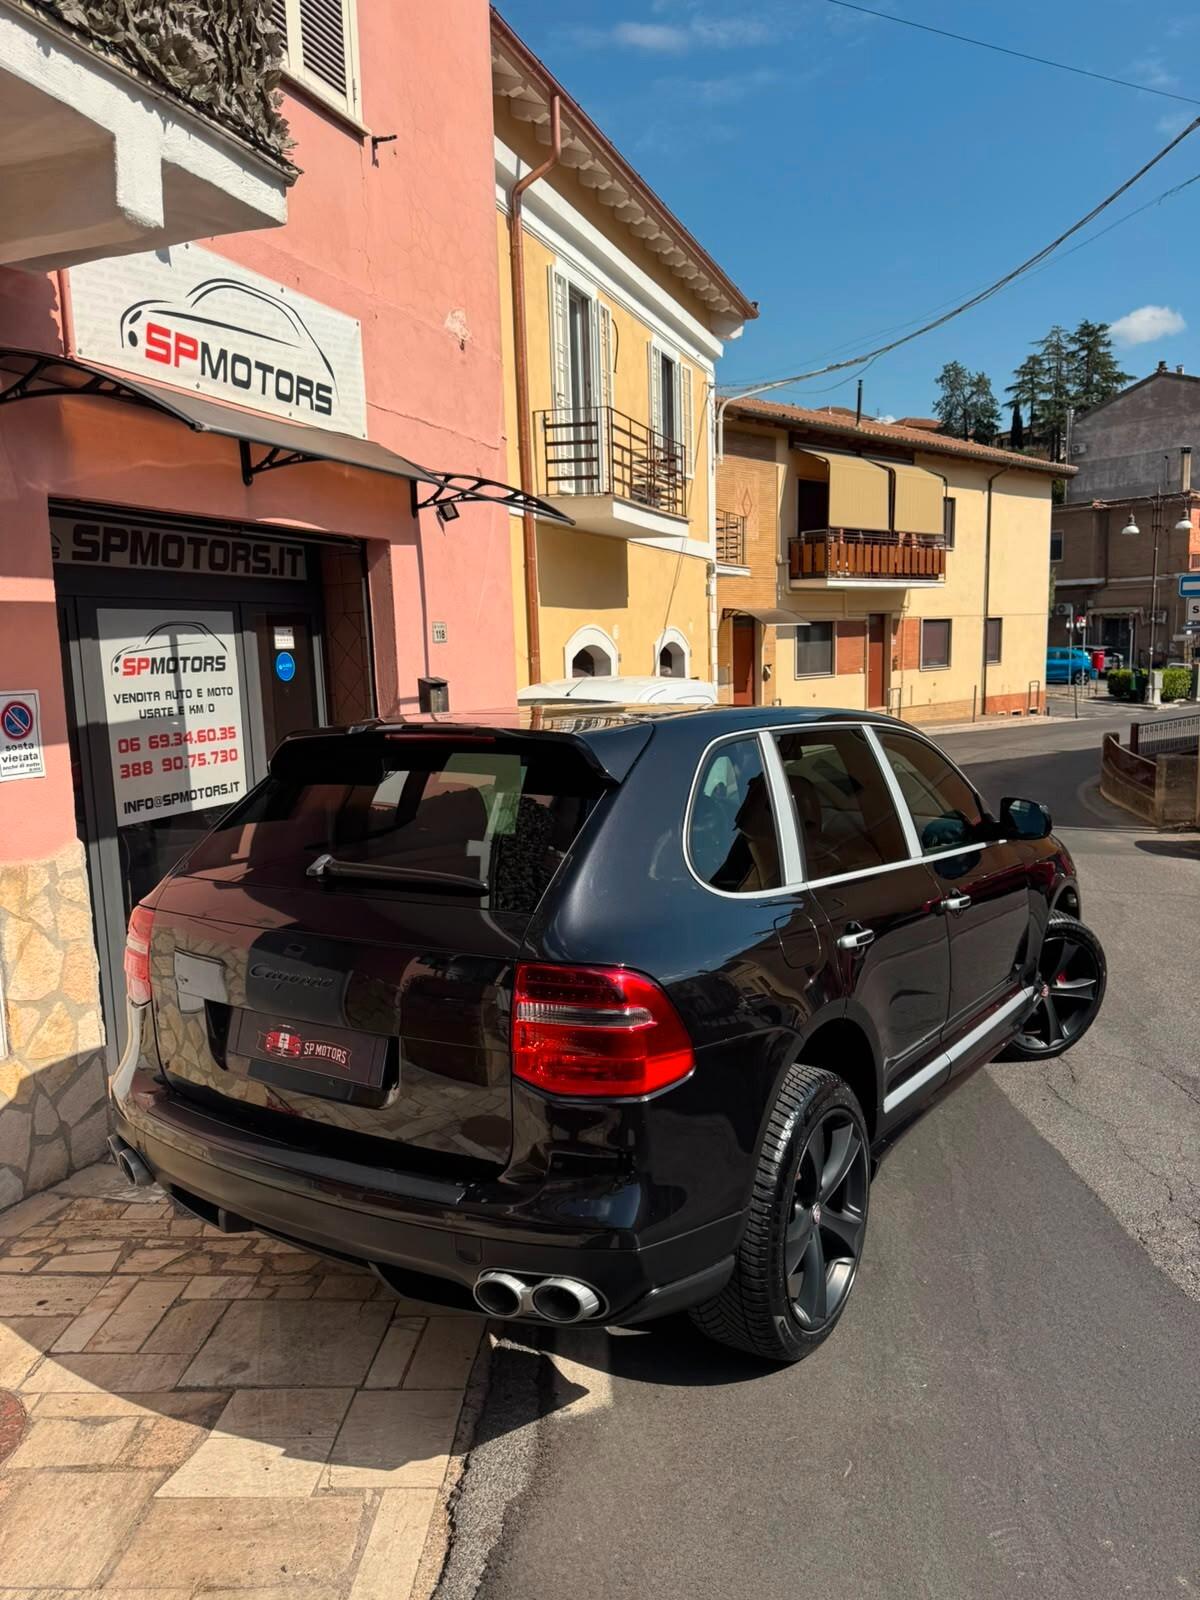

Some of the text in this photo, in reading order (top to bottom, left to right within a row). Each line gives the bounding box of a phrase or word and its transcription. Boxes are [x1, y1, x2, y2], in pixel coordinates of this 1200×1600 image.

[144, 322, 333, 416] SPMOTORS
[72, 524, 303, 577] SPMOTORS.IT
[122, 656, 226, 676] SPMOTORS
[113, 686, 233, 704] VENDITA AUTO E MOTO
[138, 706, 174, 719] USATE
[178, 706, 185, 716] E
[5, 742, 34, 752] sosta
[118, 726, 237, 753] 06 69.34.60.35
[1, 753, 38, 763] vietata
[120, 748, 238, 779] 388 90.75.730
[123, 781, 240, 814] INFO@SPMOTORS.IT
[303, 1042, 347, 1064] SP MOTORS
